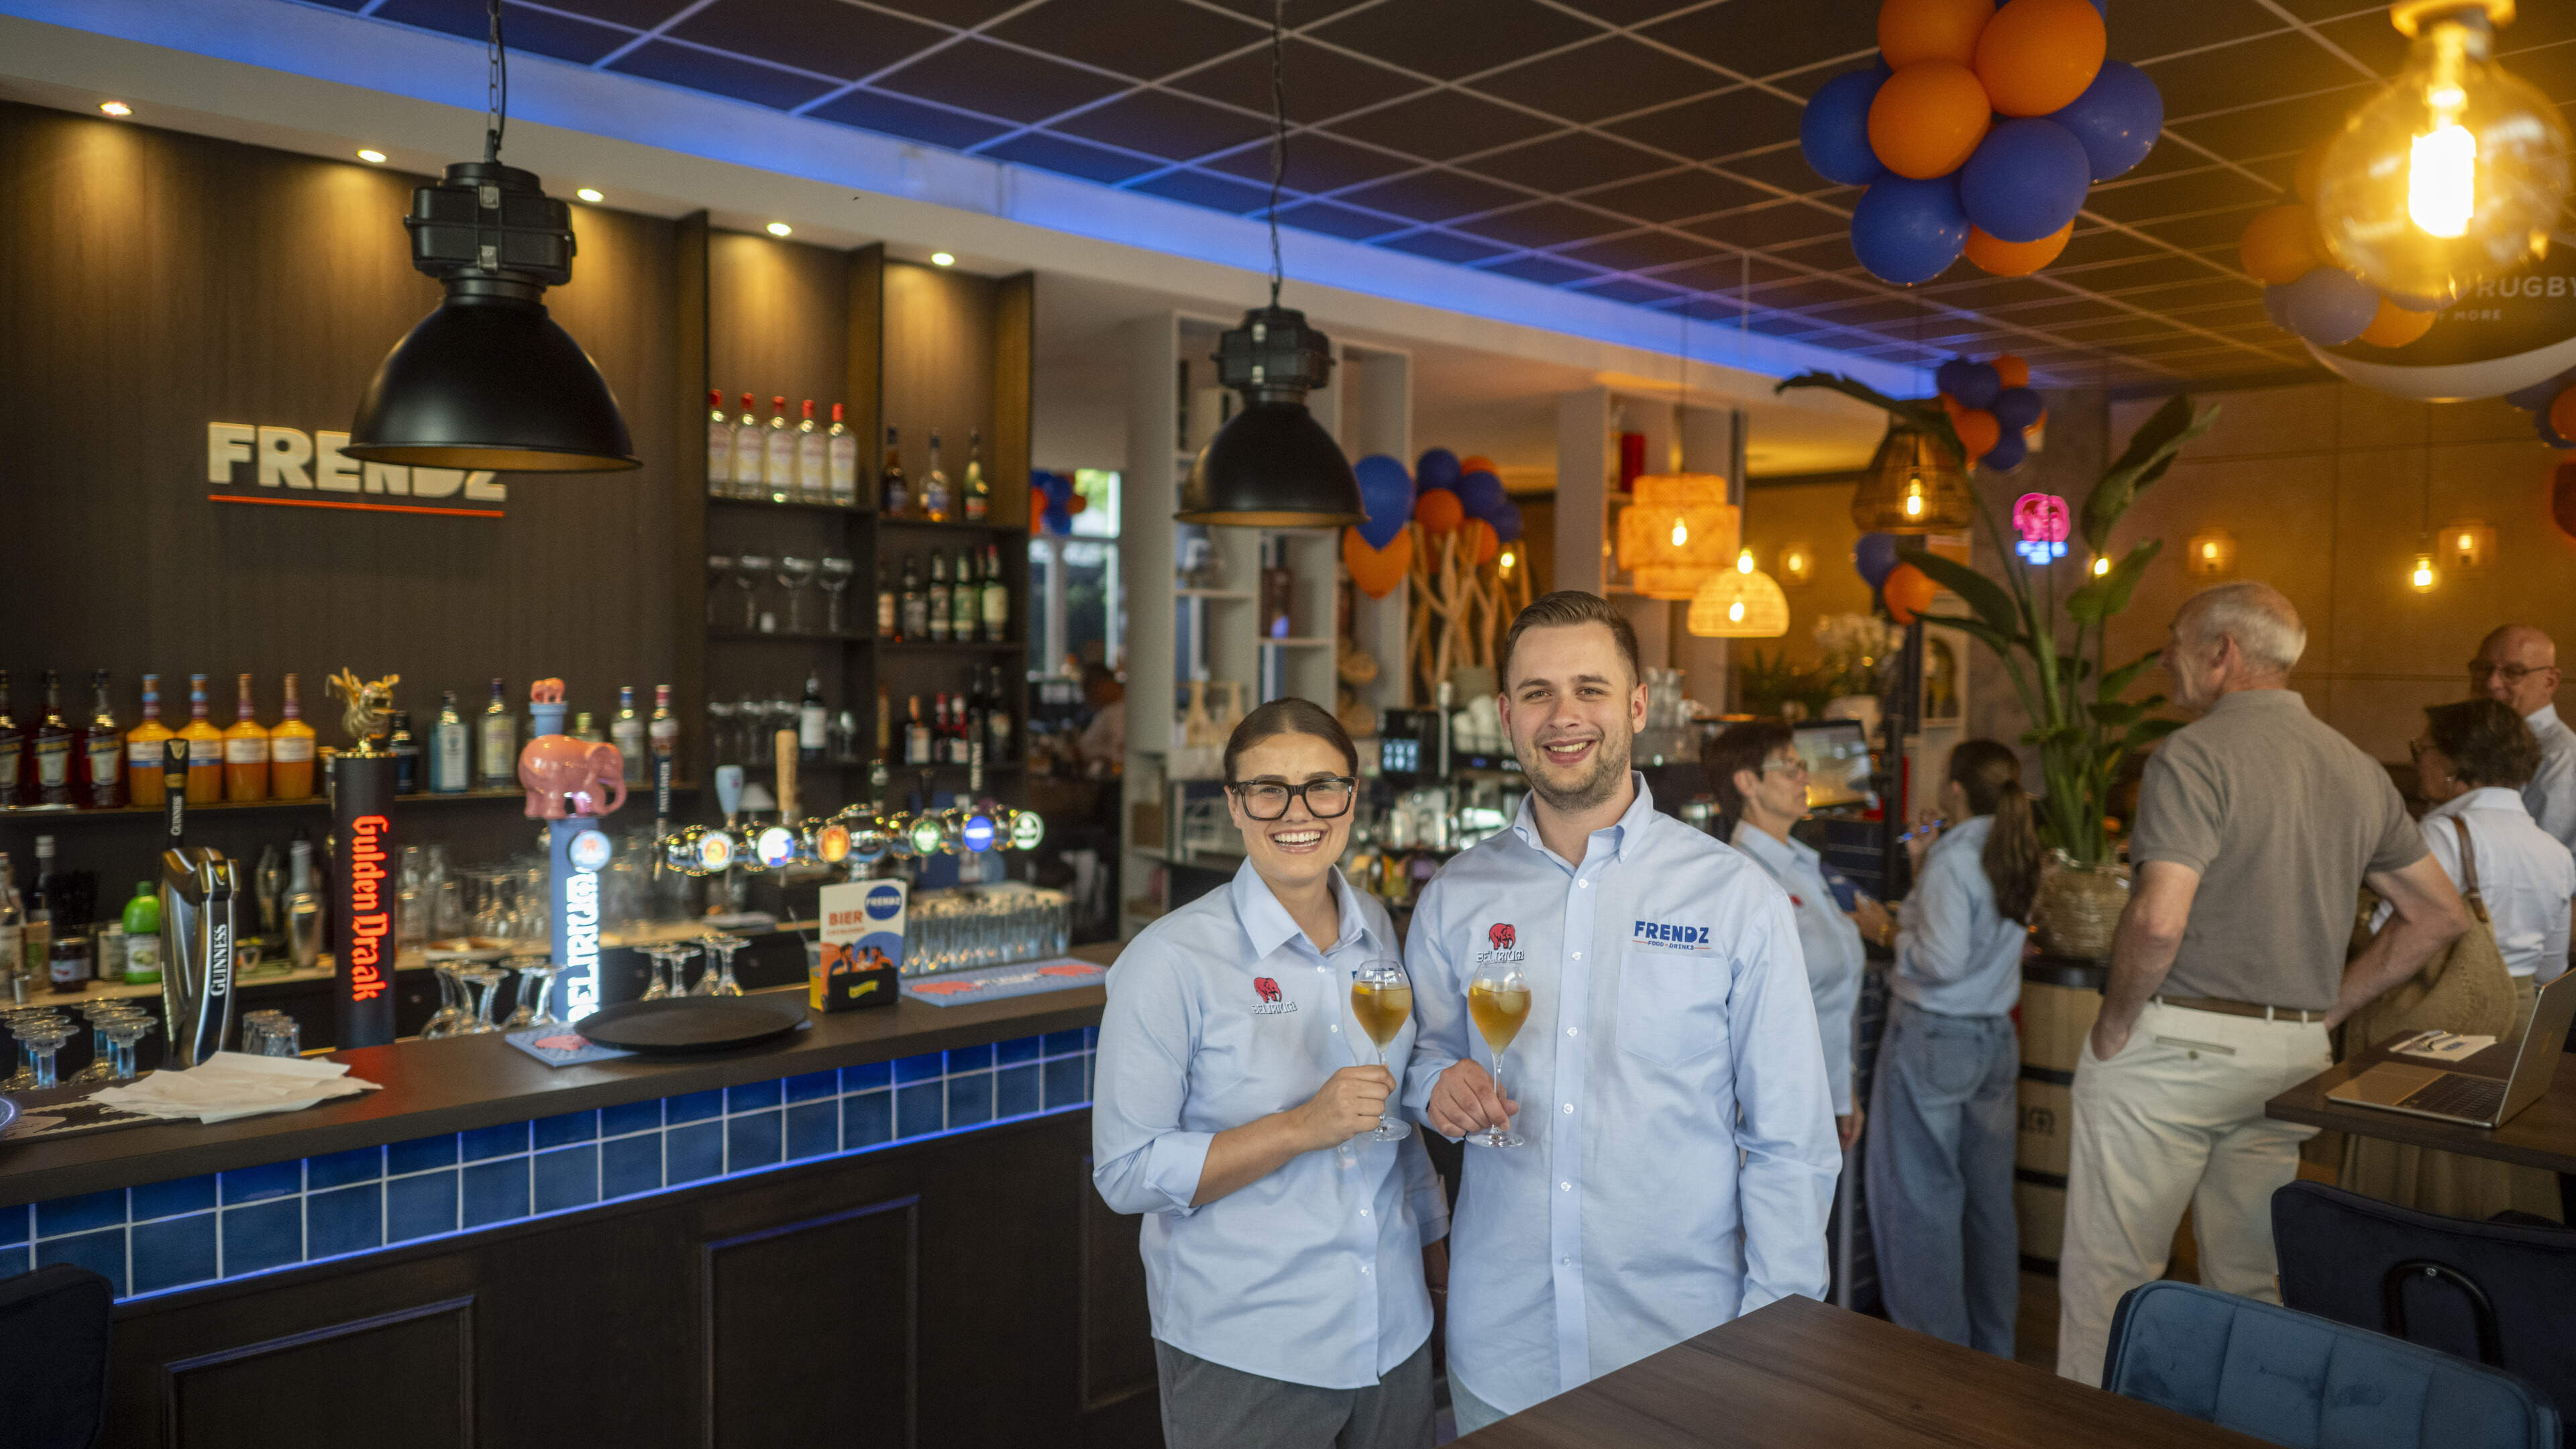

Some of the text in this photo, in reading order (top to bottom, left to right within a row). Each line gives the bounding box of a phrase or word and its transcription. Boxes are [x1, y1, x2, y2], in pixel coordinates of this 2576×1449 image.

[351, 815, 390, 1002] Gulden Draak
[828, 910, 863, 926] BIER
[1633, 920, 1709, 944] FRENDZ
[209, 924, 227, 996] GUINNESS
